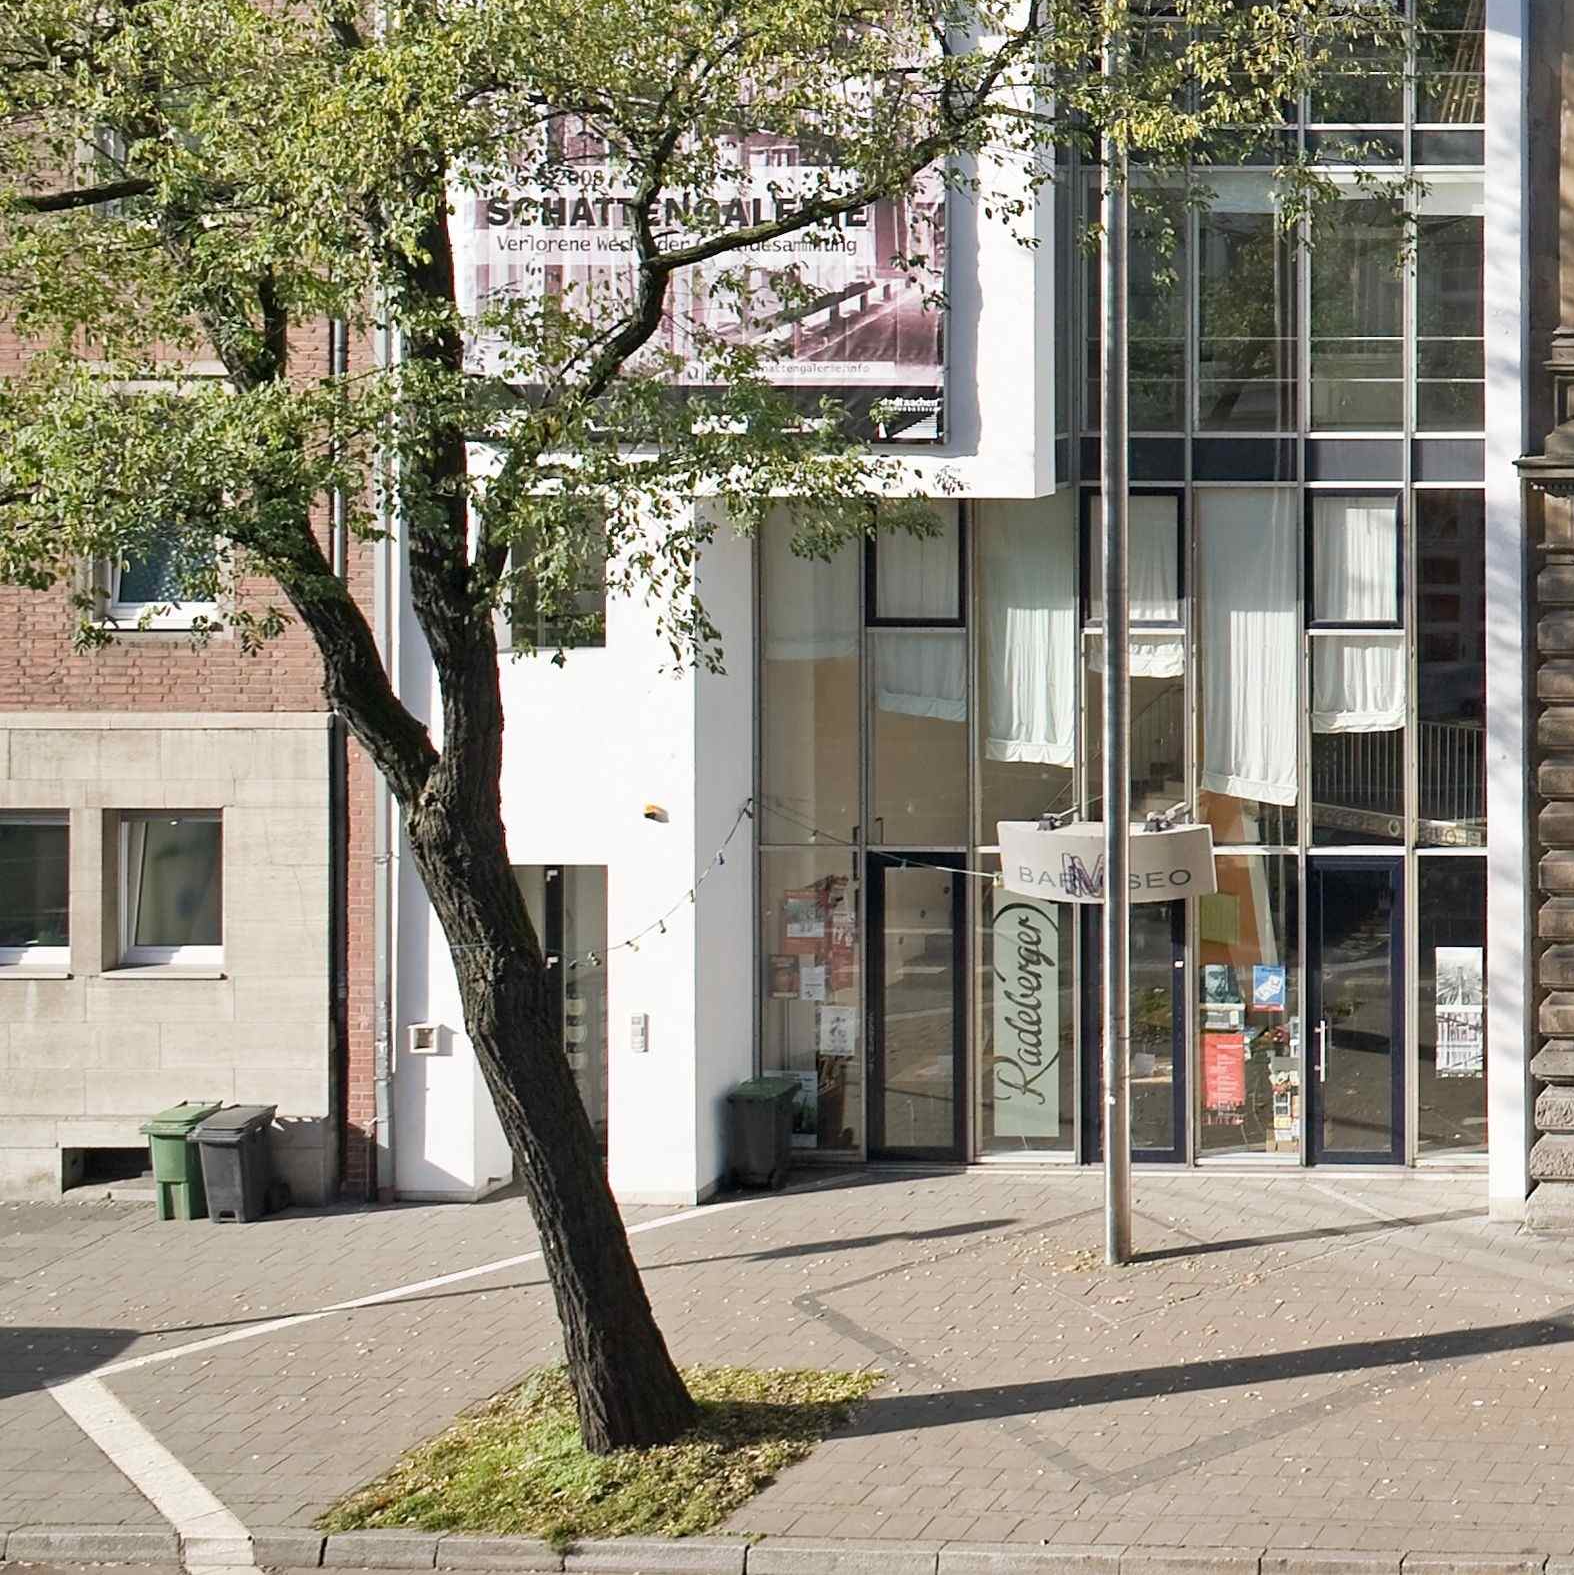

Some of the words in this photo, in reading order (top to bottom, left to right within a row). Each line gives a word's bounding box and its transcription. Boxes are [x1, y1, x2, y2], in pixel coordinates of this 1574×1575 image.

[488, 197, 869, 227] SCHATTENGALEE
[497, 234, 591, 252] Verlorene
[657, 234, 690, 251] der
[994, 910, 1059, 1106] Radeberger
